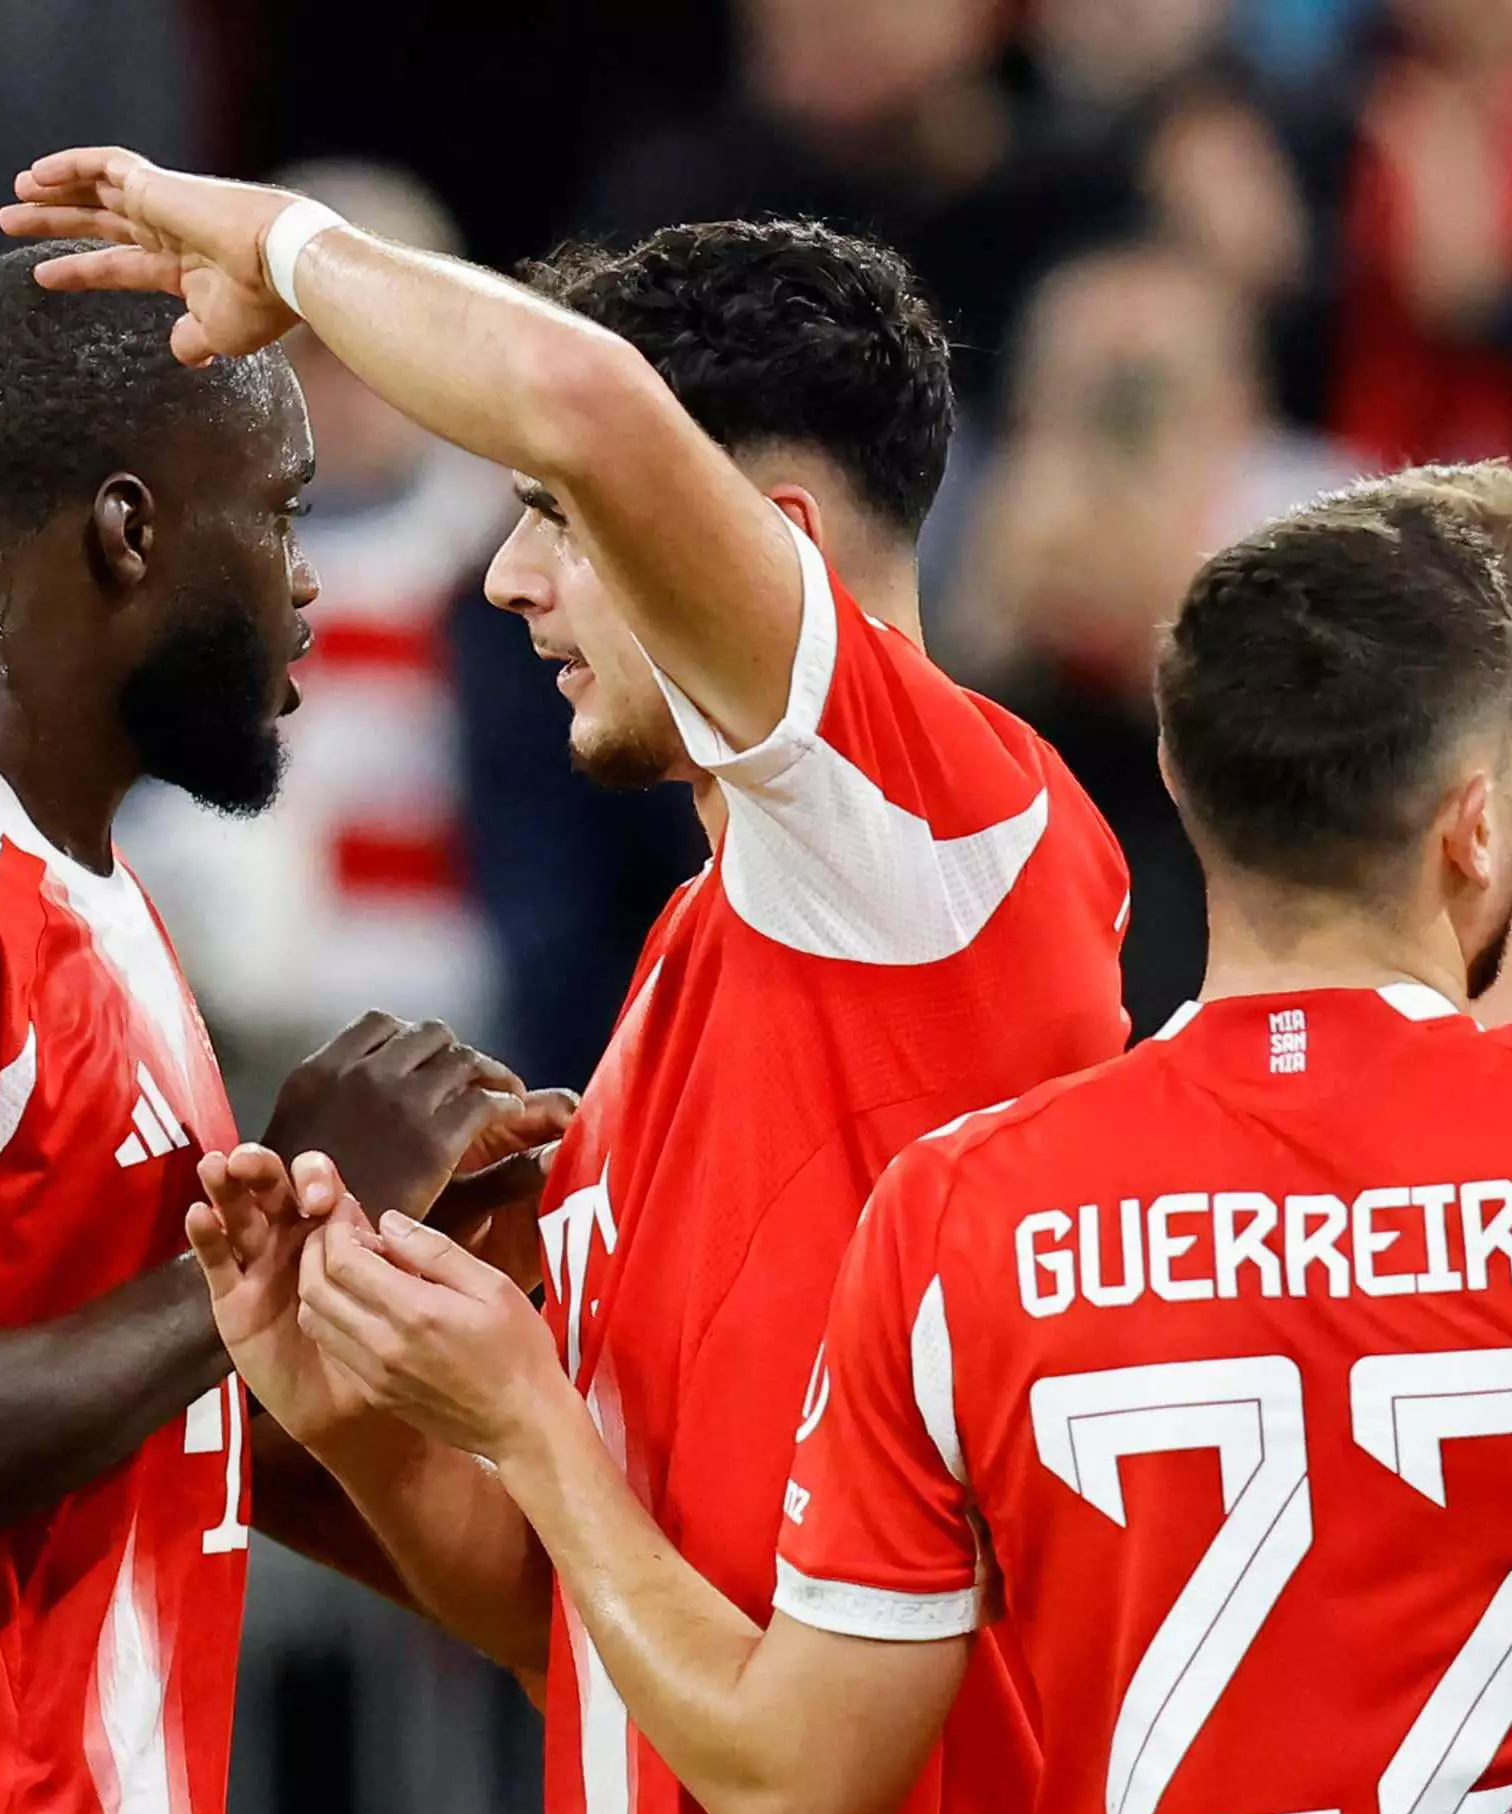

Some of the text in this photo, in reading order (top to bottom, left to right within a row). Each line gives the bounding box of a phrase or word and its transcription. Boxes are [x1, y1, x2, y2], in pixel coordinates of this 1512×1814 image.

[1268, 1008, 1306, 1033] MIA
[1269, 1031, 1307, 1054] SAN
[1269, 1052, 1306, 1074] MIA
